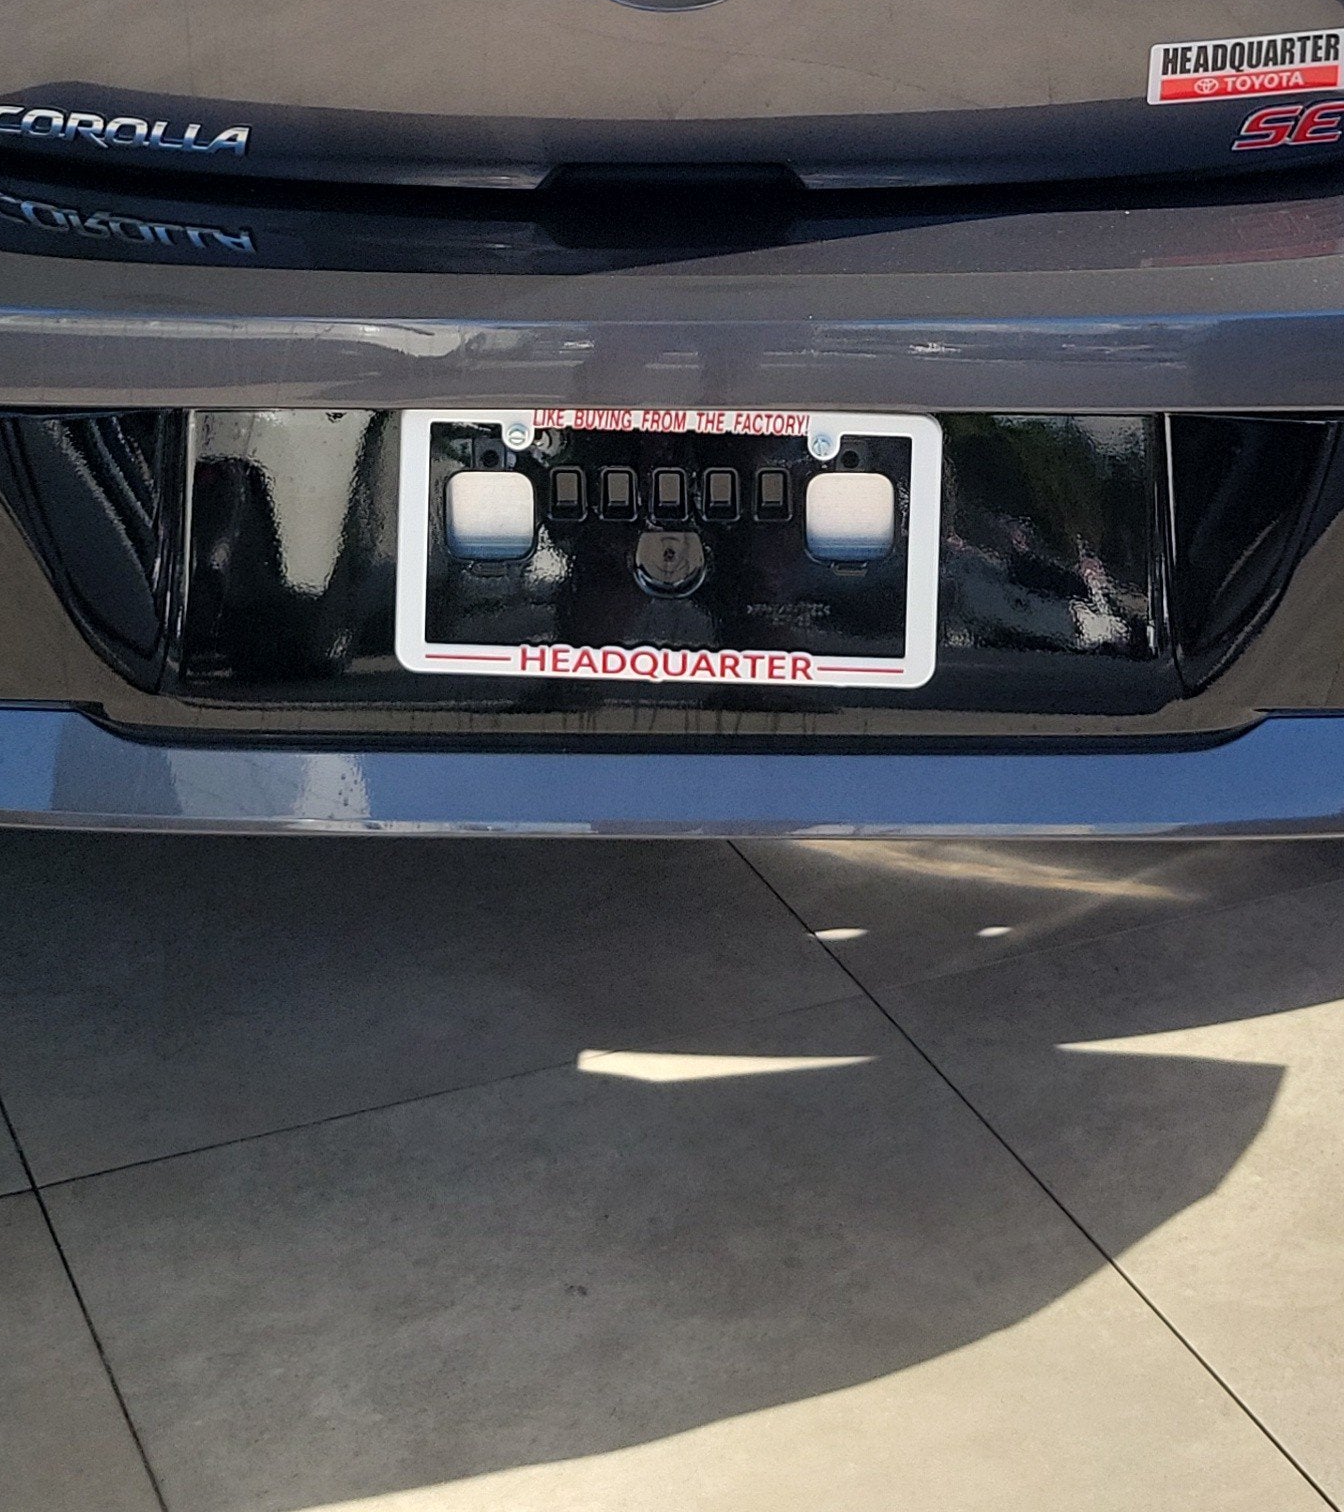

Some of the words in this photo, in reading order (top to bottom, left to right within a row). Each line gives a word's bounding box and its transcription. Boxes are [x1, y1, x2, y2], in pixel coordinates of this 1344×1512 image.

[1161, 33, 1341, 76] HEADQUARTER
[1224, 71, 1304, 92] TOYOTA
[533, 409, 564, 426] LIKE
[574, 409, 631, 429] BUYING
[641, 410, 686, 431] FROM
[696, 412, 725, 431] THE
[734, 414, 810, 435] FACTORY!
[520, 646, 813, 680] HEADQUARTER
